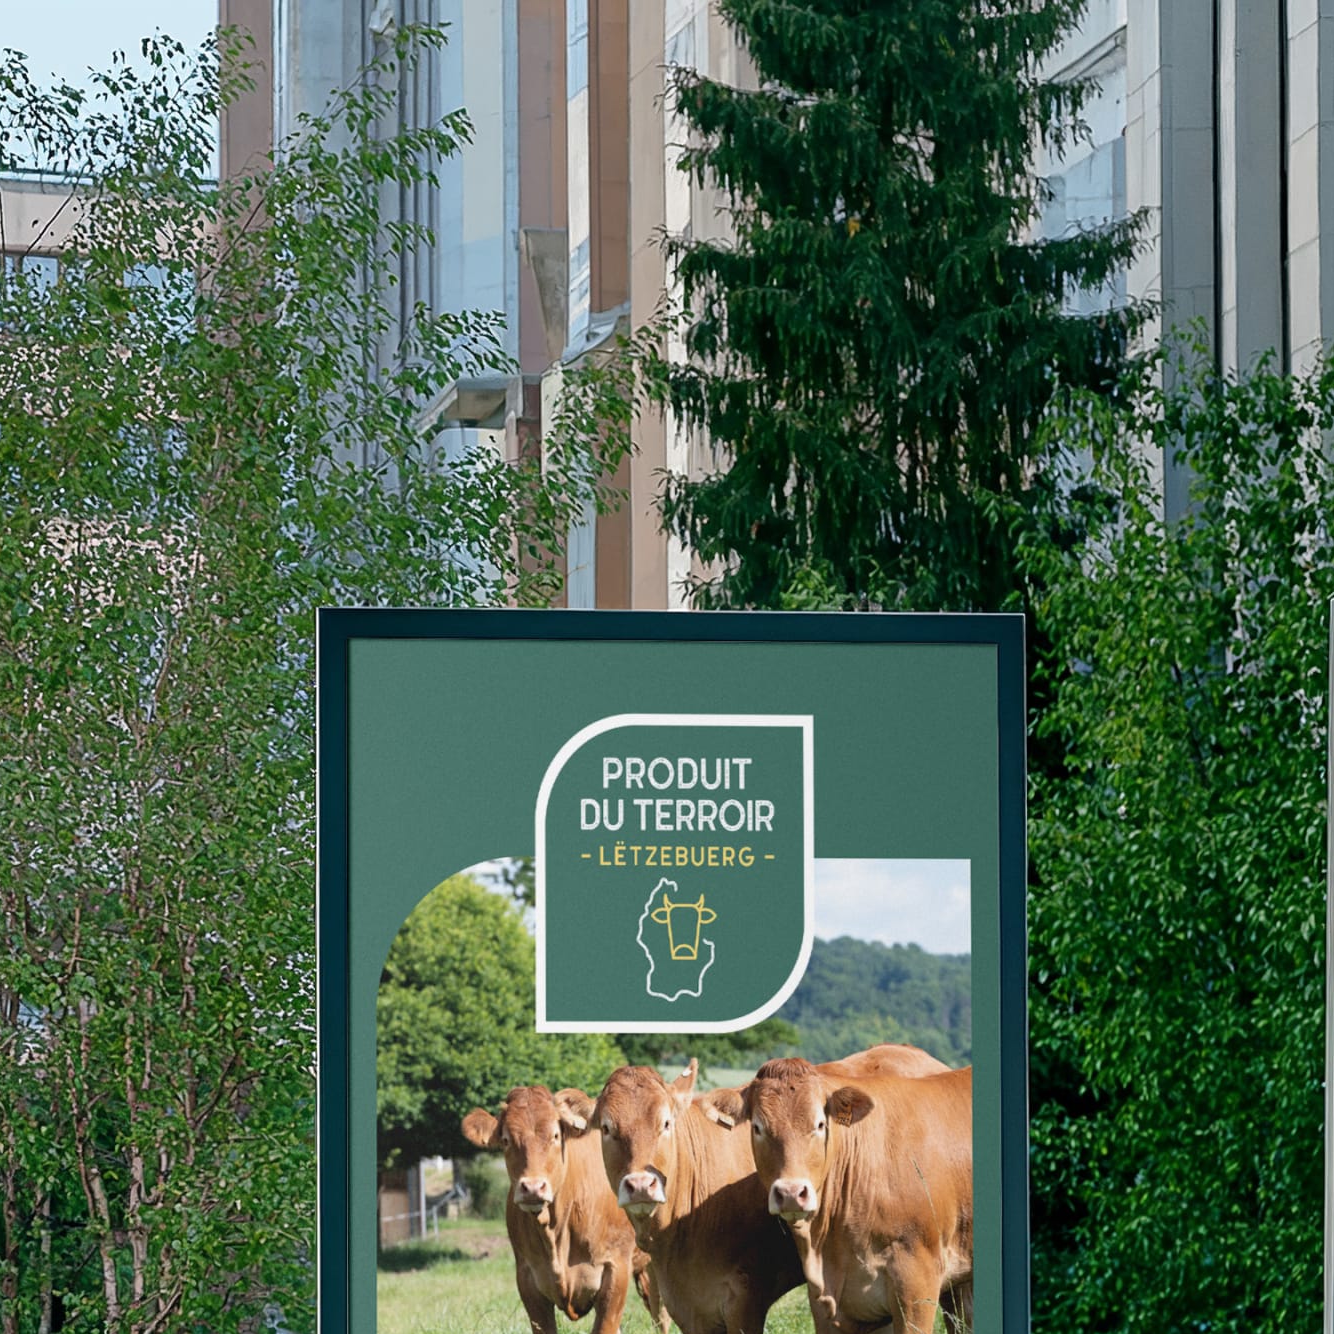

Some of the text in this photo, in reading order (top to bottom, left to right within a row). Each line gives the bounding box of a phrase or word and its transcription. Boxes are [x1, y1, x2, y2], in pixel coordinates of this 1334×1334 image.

[602, 756, 753, 791] PRODUIT
[580, 798, 775, 832] DU TERROIR
[599, 840, 755, 867] LËTZEBUERG
